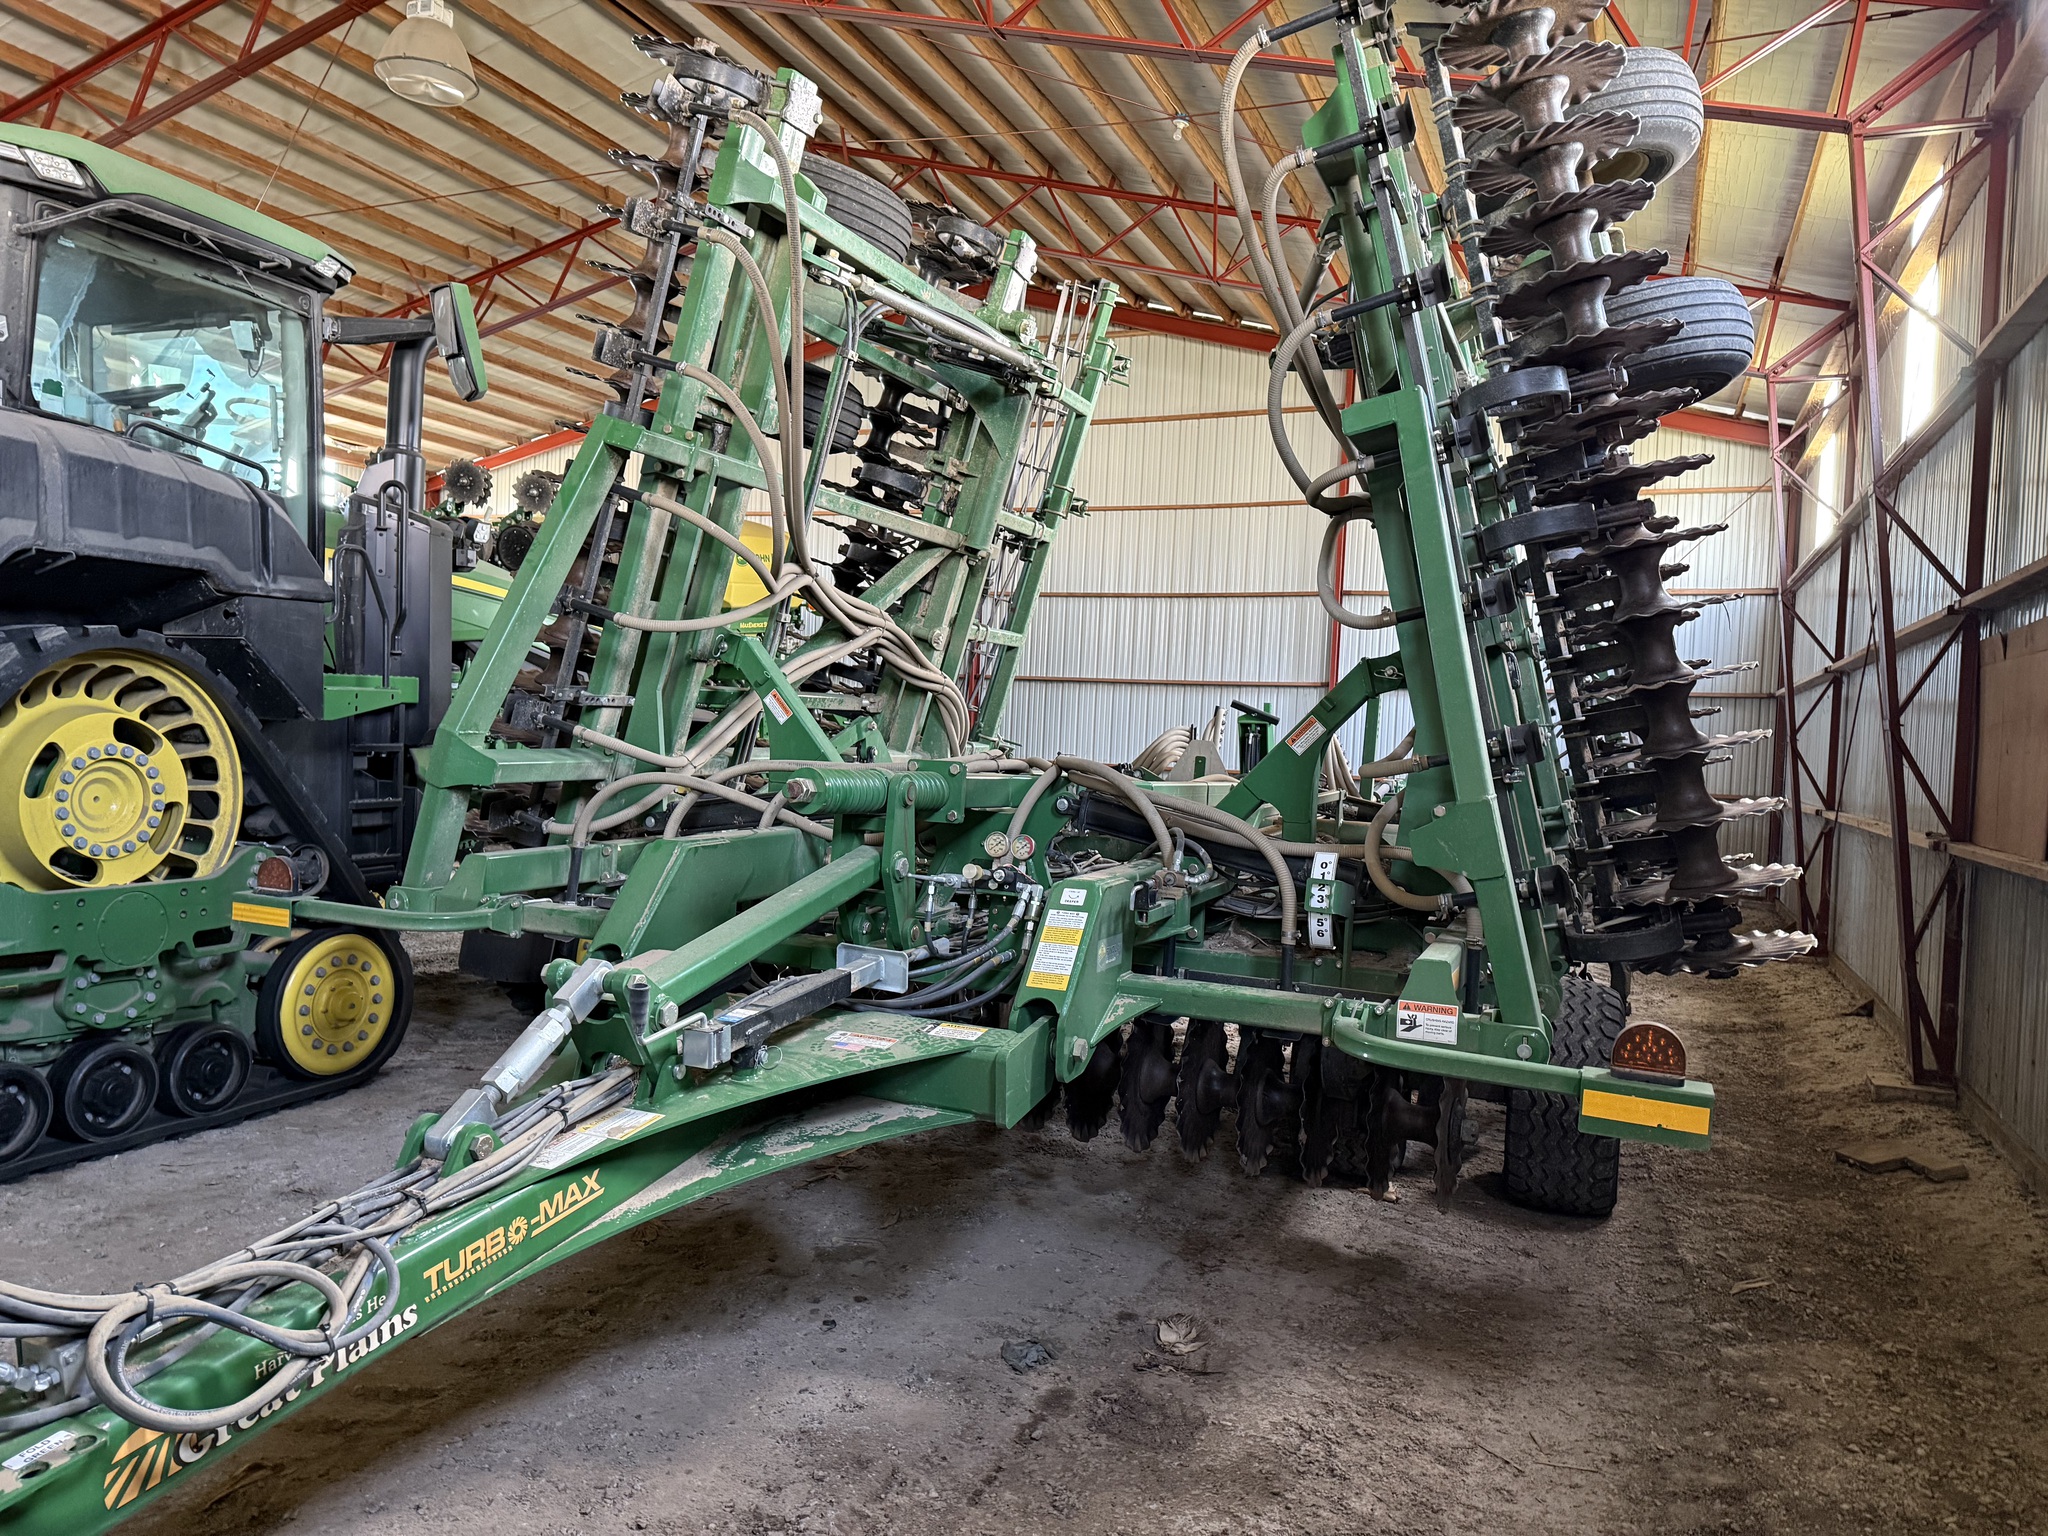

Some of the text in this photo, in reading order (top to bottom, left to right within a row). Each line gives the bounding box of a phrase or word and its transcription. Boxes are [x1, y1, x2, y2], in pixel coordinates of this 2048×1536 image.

[1413, 1004, 1453, 1015] WARNING
[254, 1350, 294, 1381] Harv
[366, 1294, 387, 1314] He
[311, 1303, 418, 1388] Plains
[19, 1439, 51, 1458] FOLD
[23, 1439, 65, 1463] GREEN
